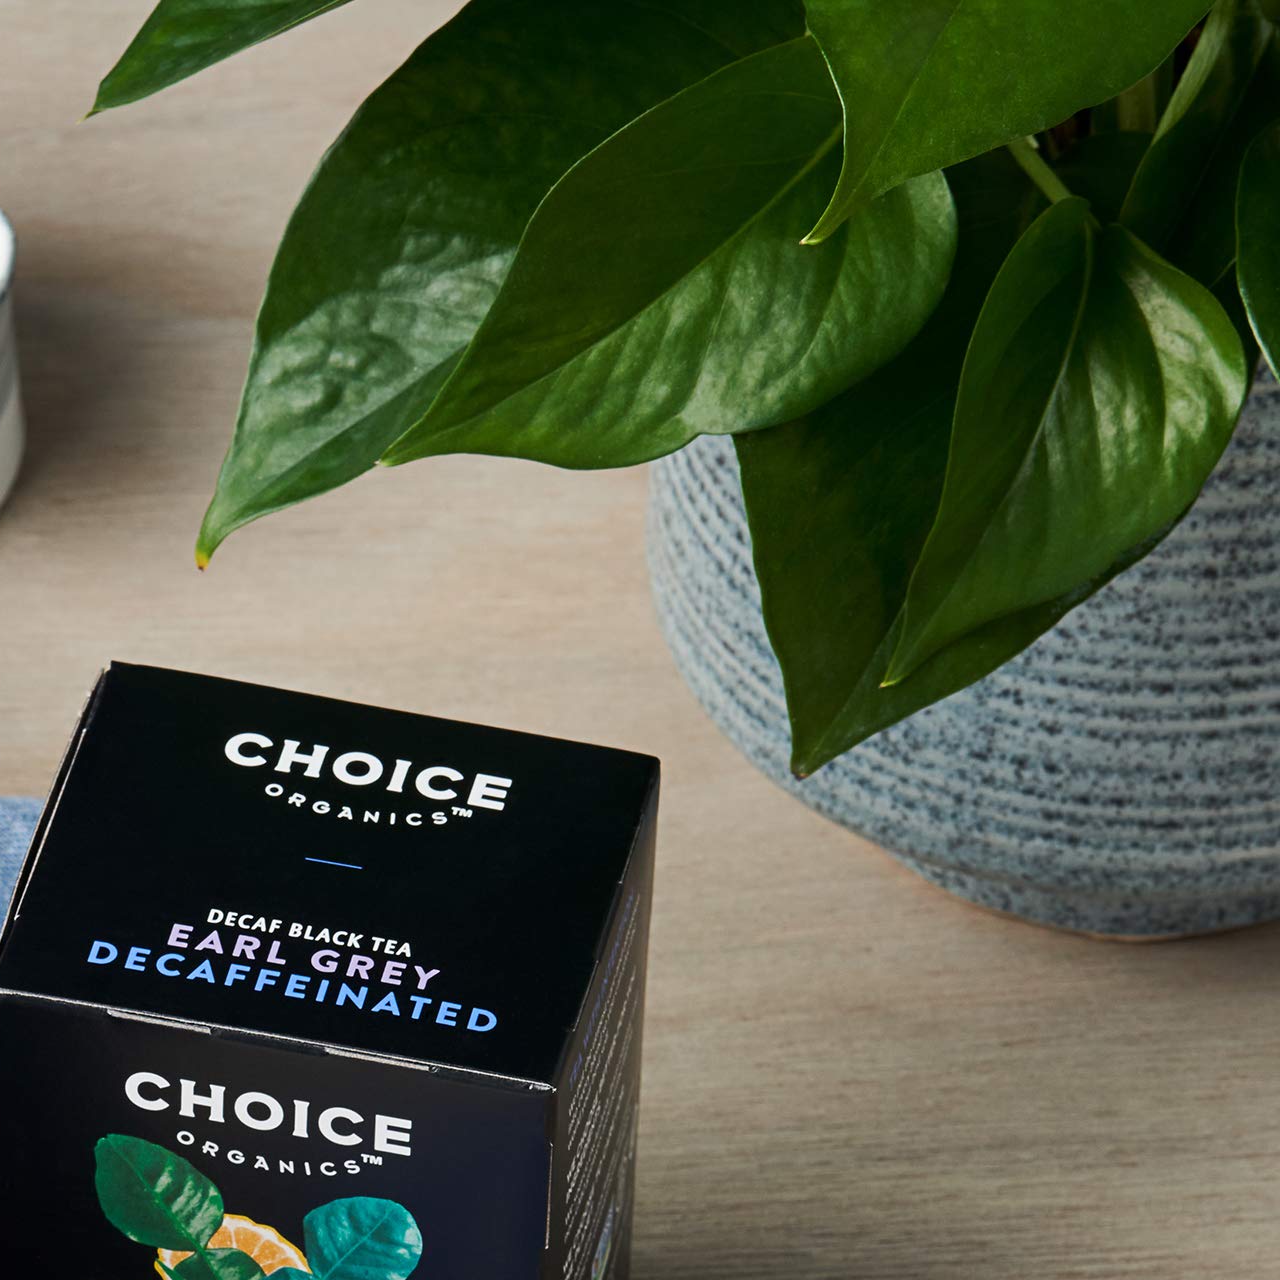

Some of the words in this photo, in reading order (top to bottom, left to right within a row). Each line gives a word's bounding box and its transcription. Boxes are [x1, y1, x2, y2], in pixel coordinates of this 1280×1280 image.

[224, 733, 512, 811] CHOICE
[167, 924, 285, 965] EARL
[311, 950, 440, 990] GREY
[207, 908, 282, 935] DECAF
[288, 922, 363, 948] BLACK
[369, 935, 412, 957] TEA
[87, 941, 497, 1032] DECAFFEINATED
[125, 1072, 412, 1156] CHOICE
